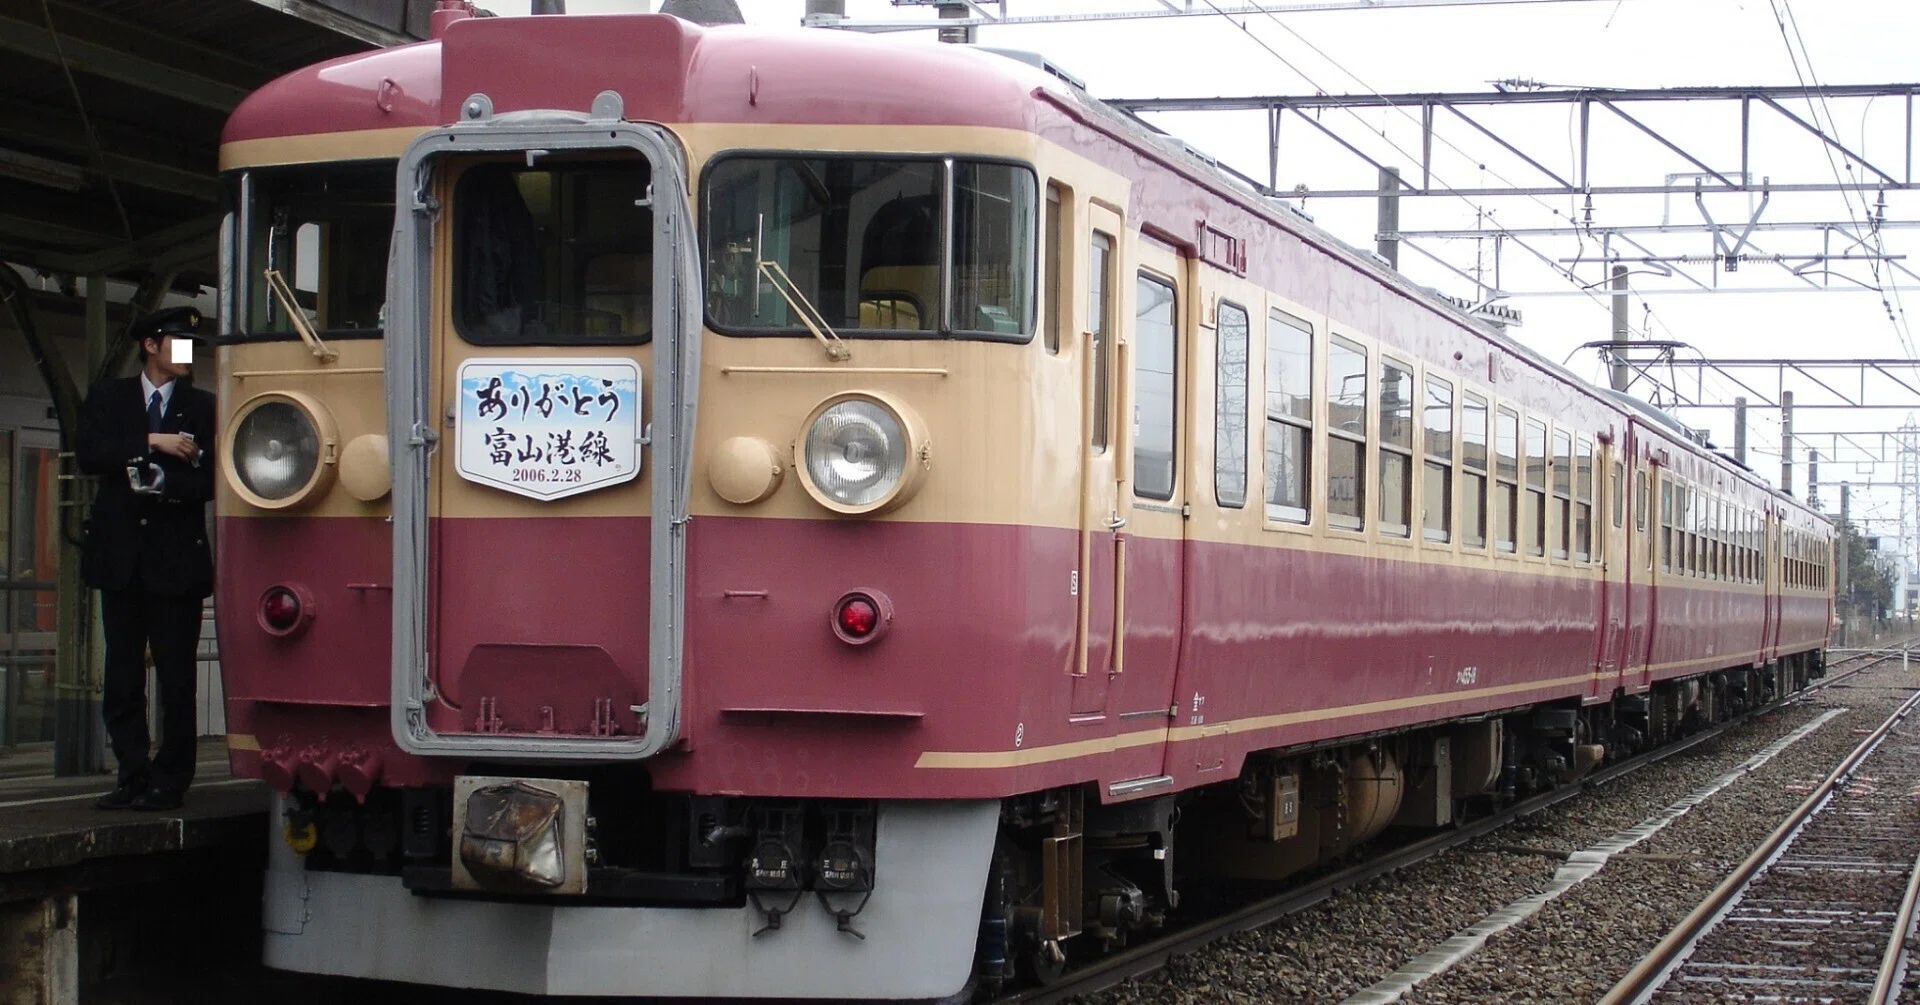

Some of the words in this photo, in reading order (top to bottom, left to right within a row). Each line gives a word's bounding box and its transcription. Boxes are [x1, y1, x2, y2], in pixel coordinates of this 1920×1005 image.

[476, 377, 619, 422] ありがとう
[485, 427, 615, 467] 富山港線
[512, 468, 582, 482] 2006.2.28
